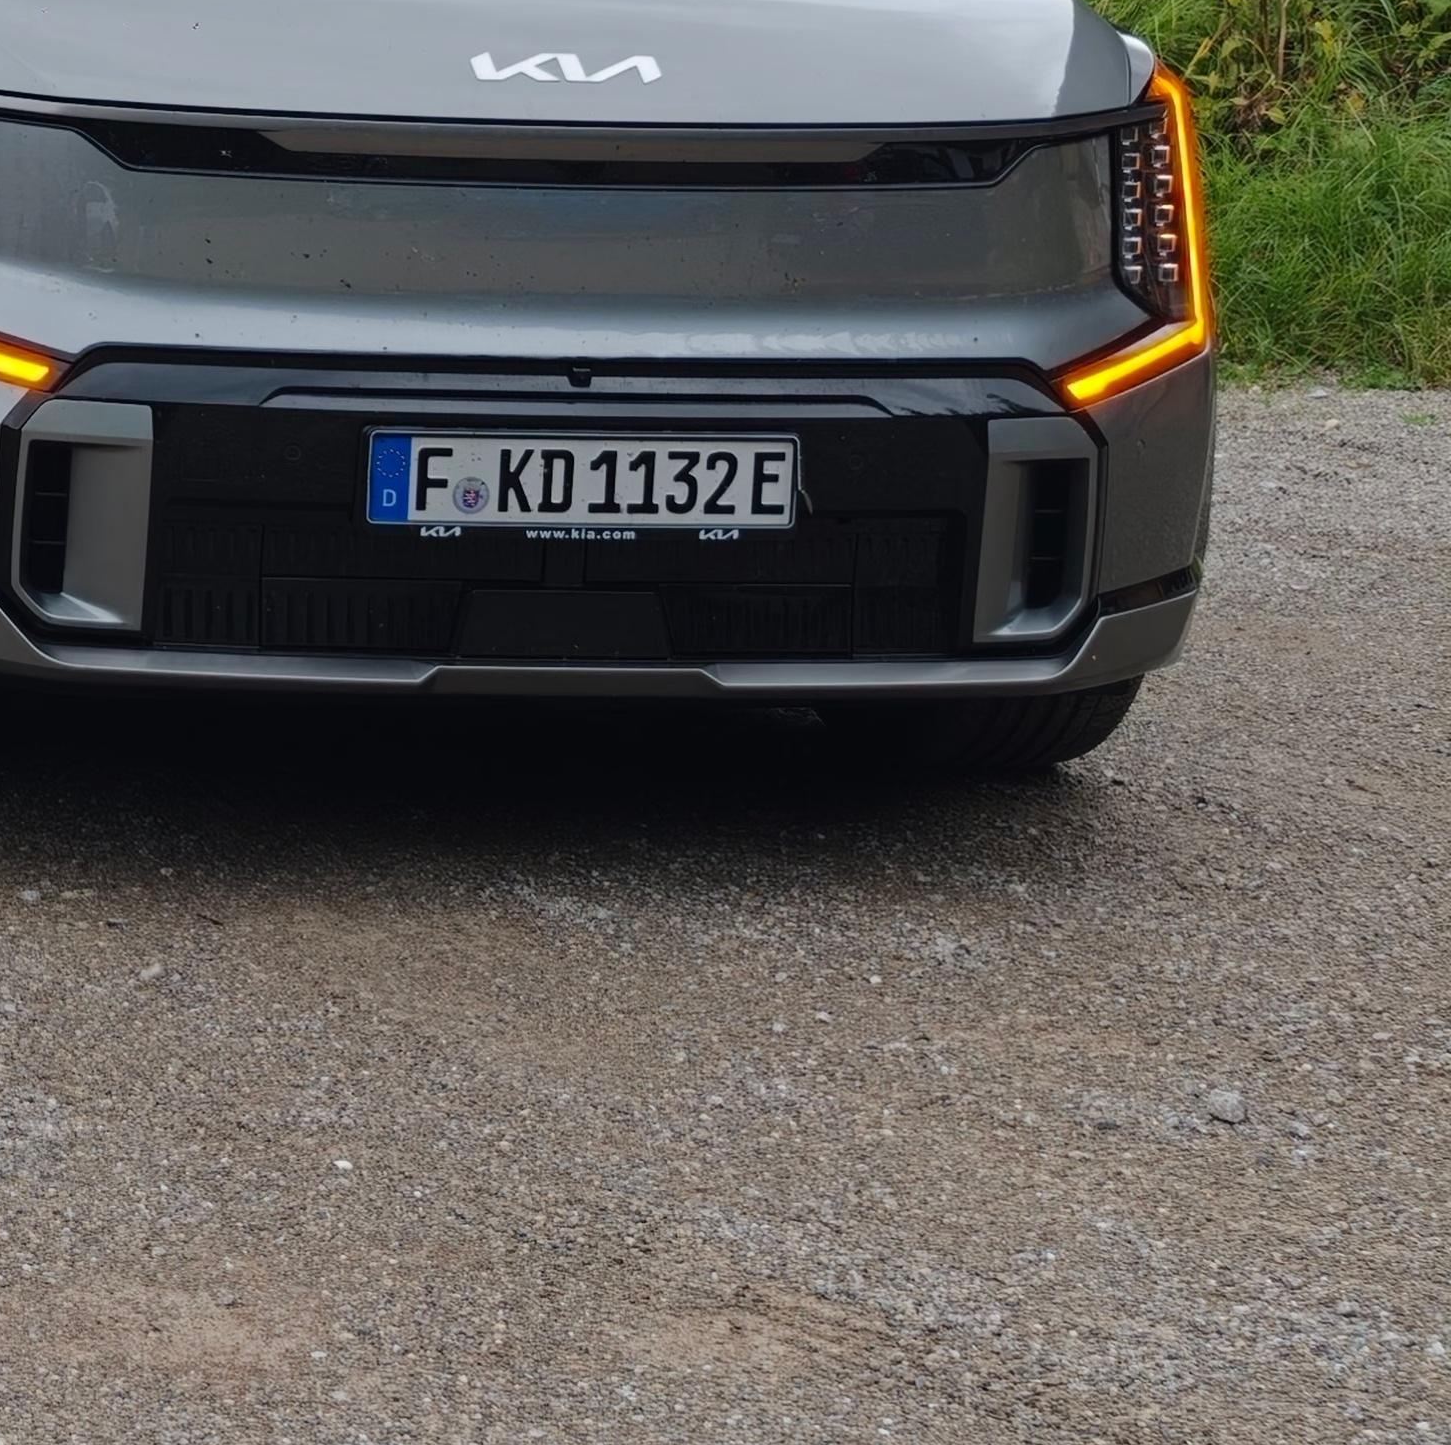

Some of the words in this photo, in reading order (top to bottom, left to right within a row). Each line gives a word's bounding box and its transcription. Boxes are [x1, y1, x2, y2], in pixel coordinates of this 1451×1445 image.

[470, 51, 662, 84] KIA
[415, 447, 453, 511] F
[383, 489, 396, 507] D
[419, 526, 462, 537] KIA
[525, 528, 636, 540] www.kia.com
[698, 529, 740, 541] KIA
